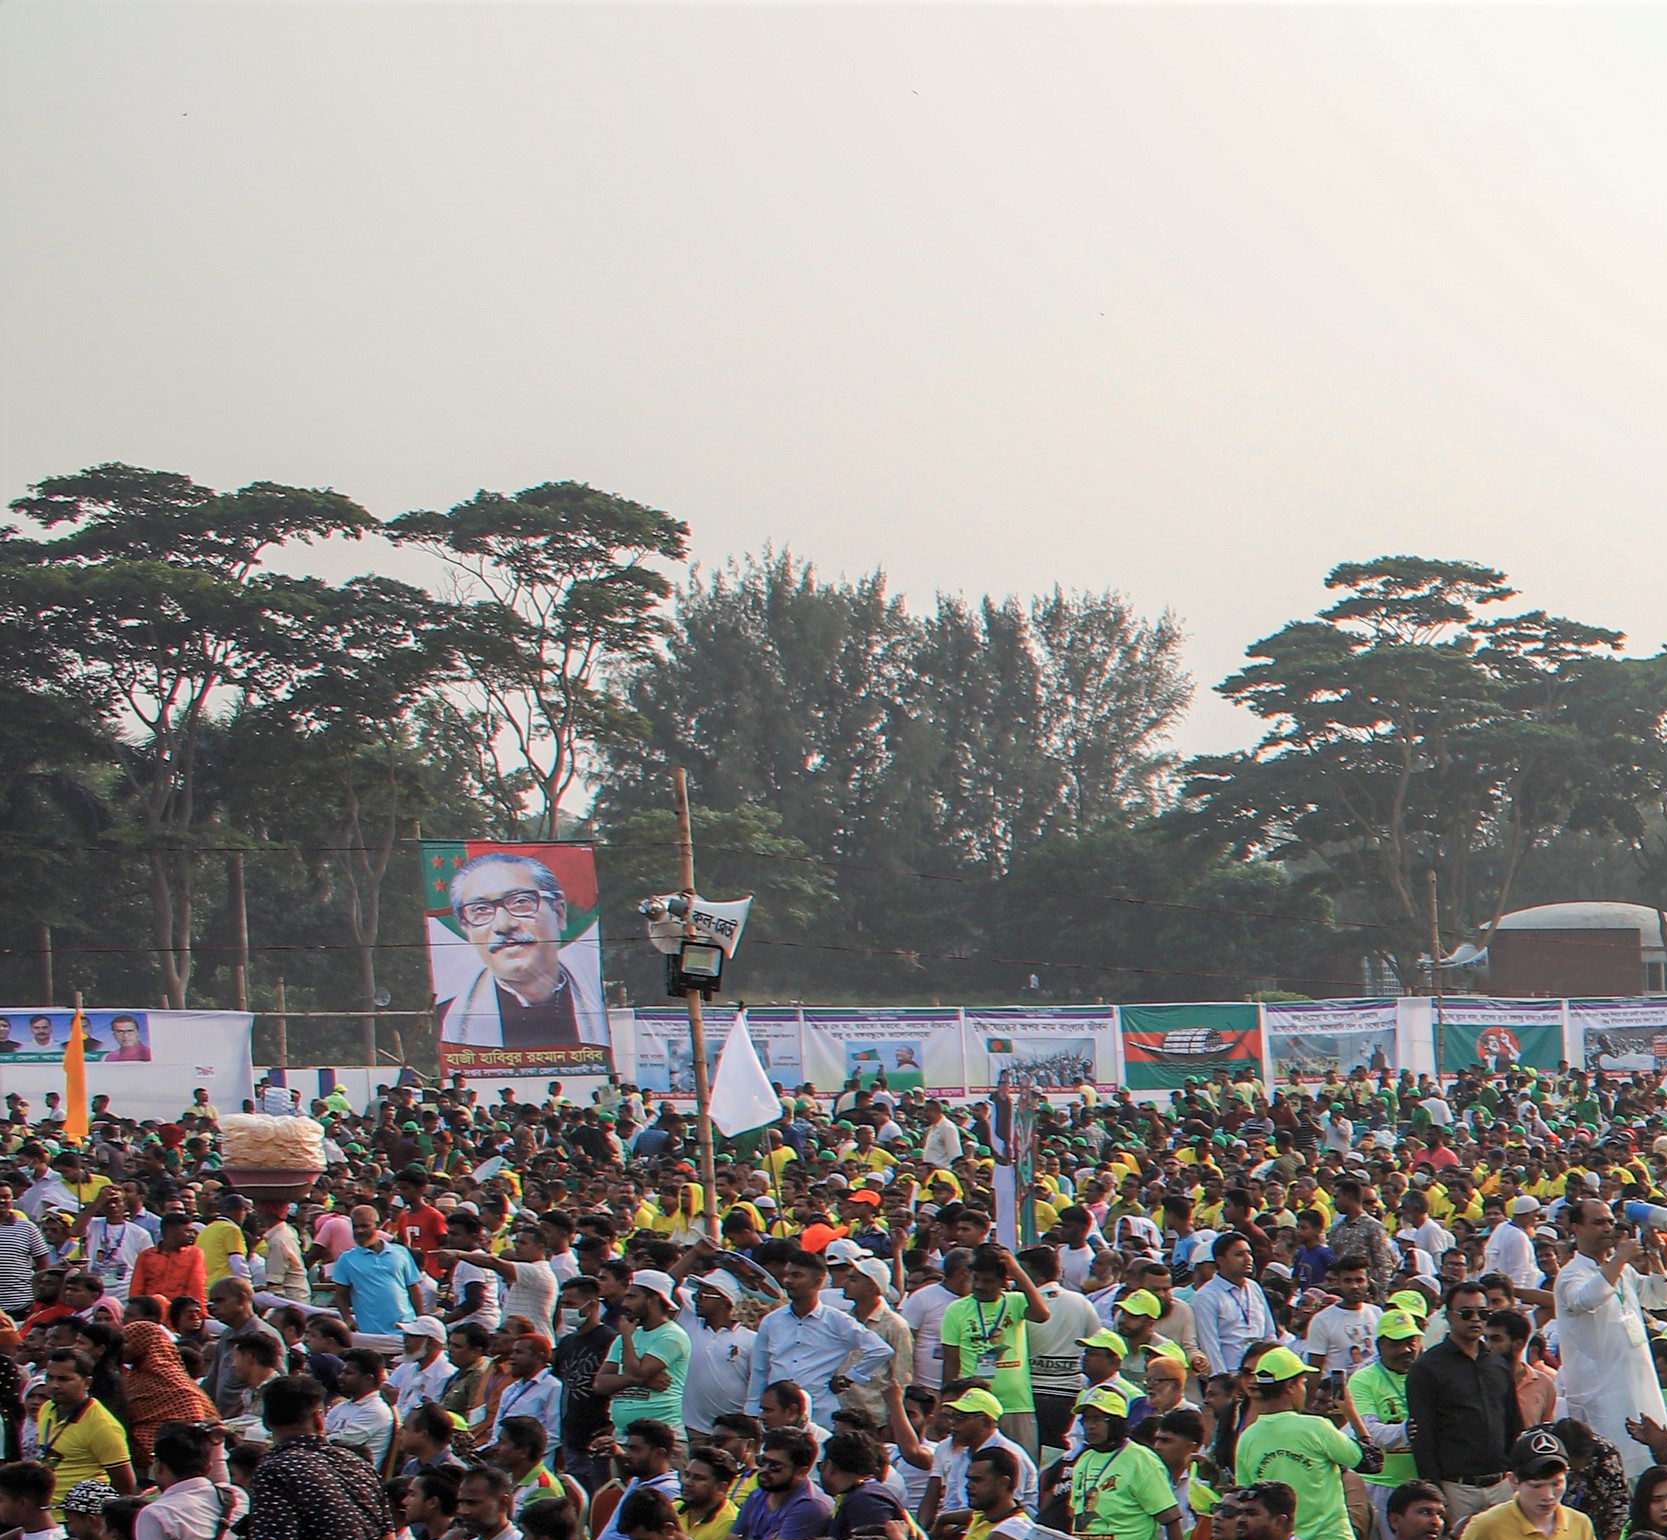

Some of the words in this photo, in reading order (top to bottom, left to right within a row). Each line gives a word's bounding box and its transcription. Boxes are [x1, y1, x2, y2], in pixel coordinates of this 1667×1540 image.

[444, 1049, 476, 1065] হাজী
[478, 1048, 522, 1067] হাবিবুর
[525, 1051, 566, 1064] রহমান
[569, 1047, 604, 1062] হাবিব
